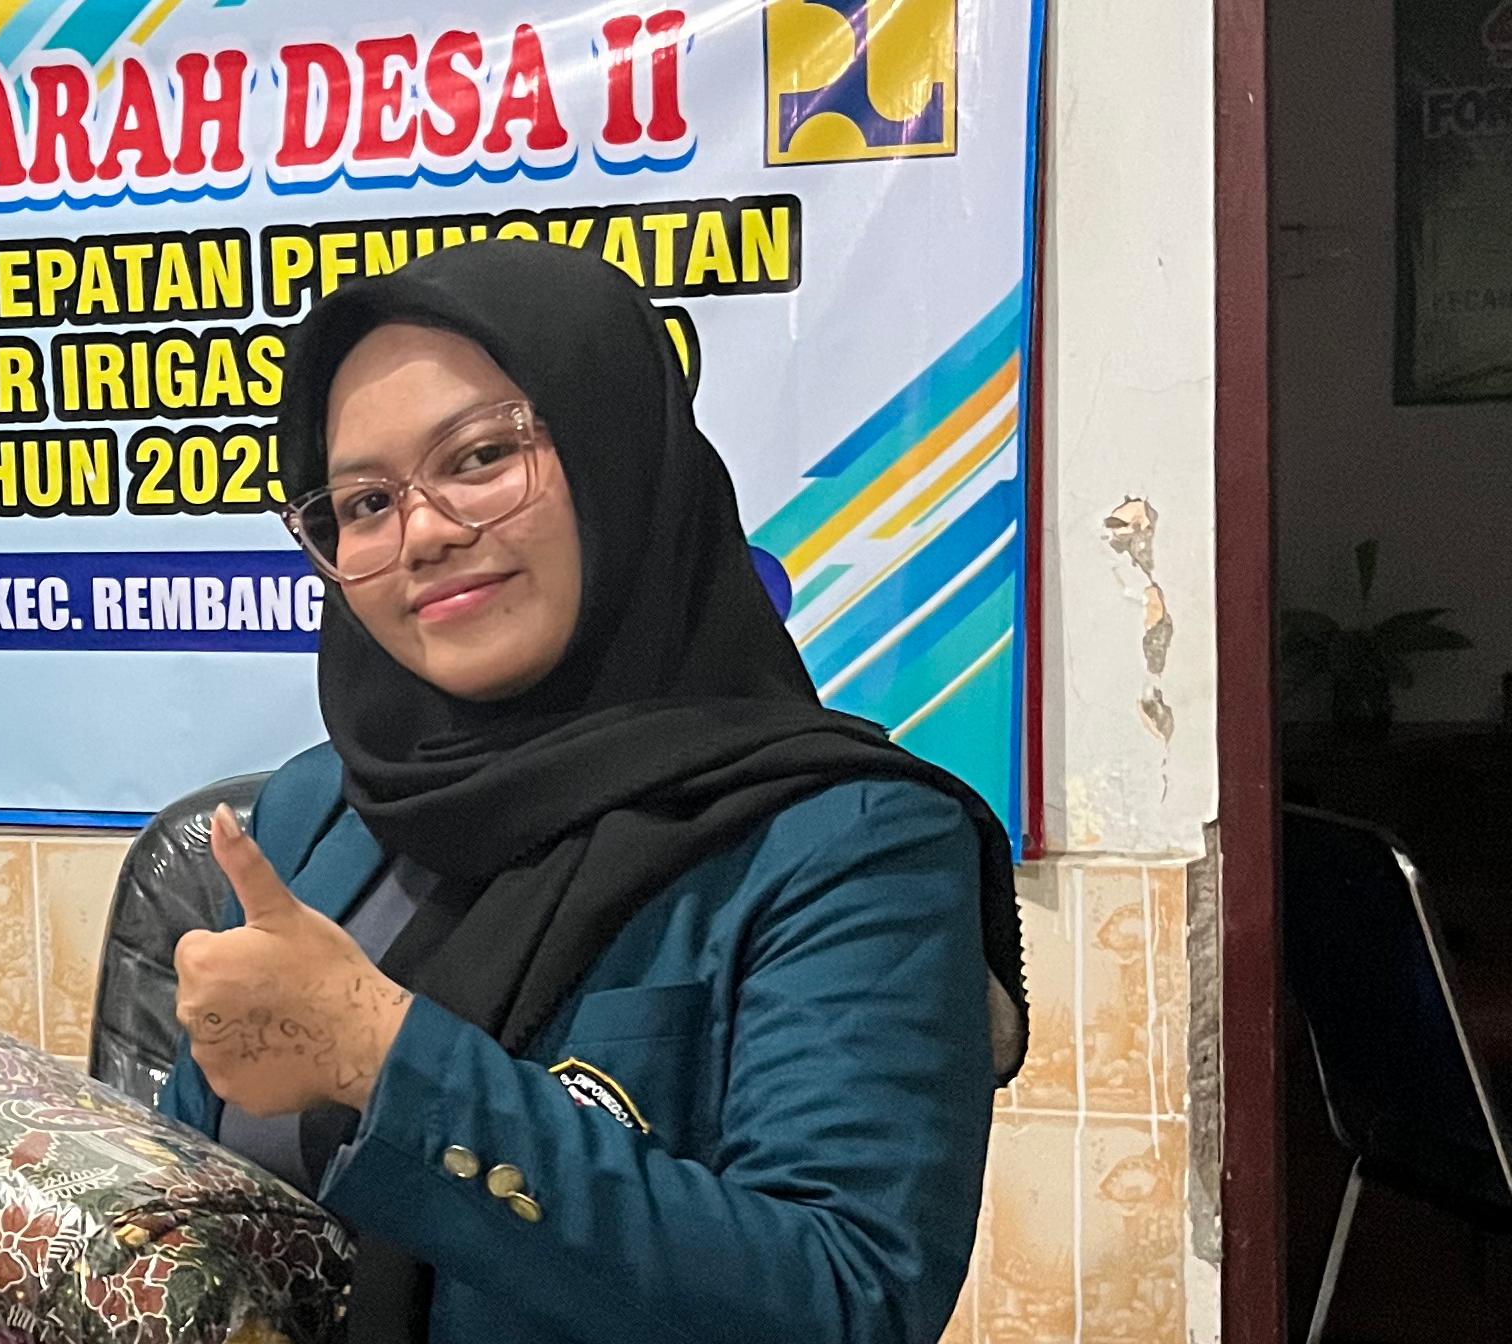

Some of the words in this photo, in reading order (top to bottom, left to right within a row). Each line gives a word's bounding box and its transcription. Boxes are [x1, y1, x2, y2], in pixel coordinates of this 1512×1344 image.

[275, 23, 569, 168] DESA
[270, 207, 791, 307] PENATAN
[92, 574, 326, 633] REMBANG
